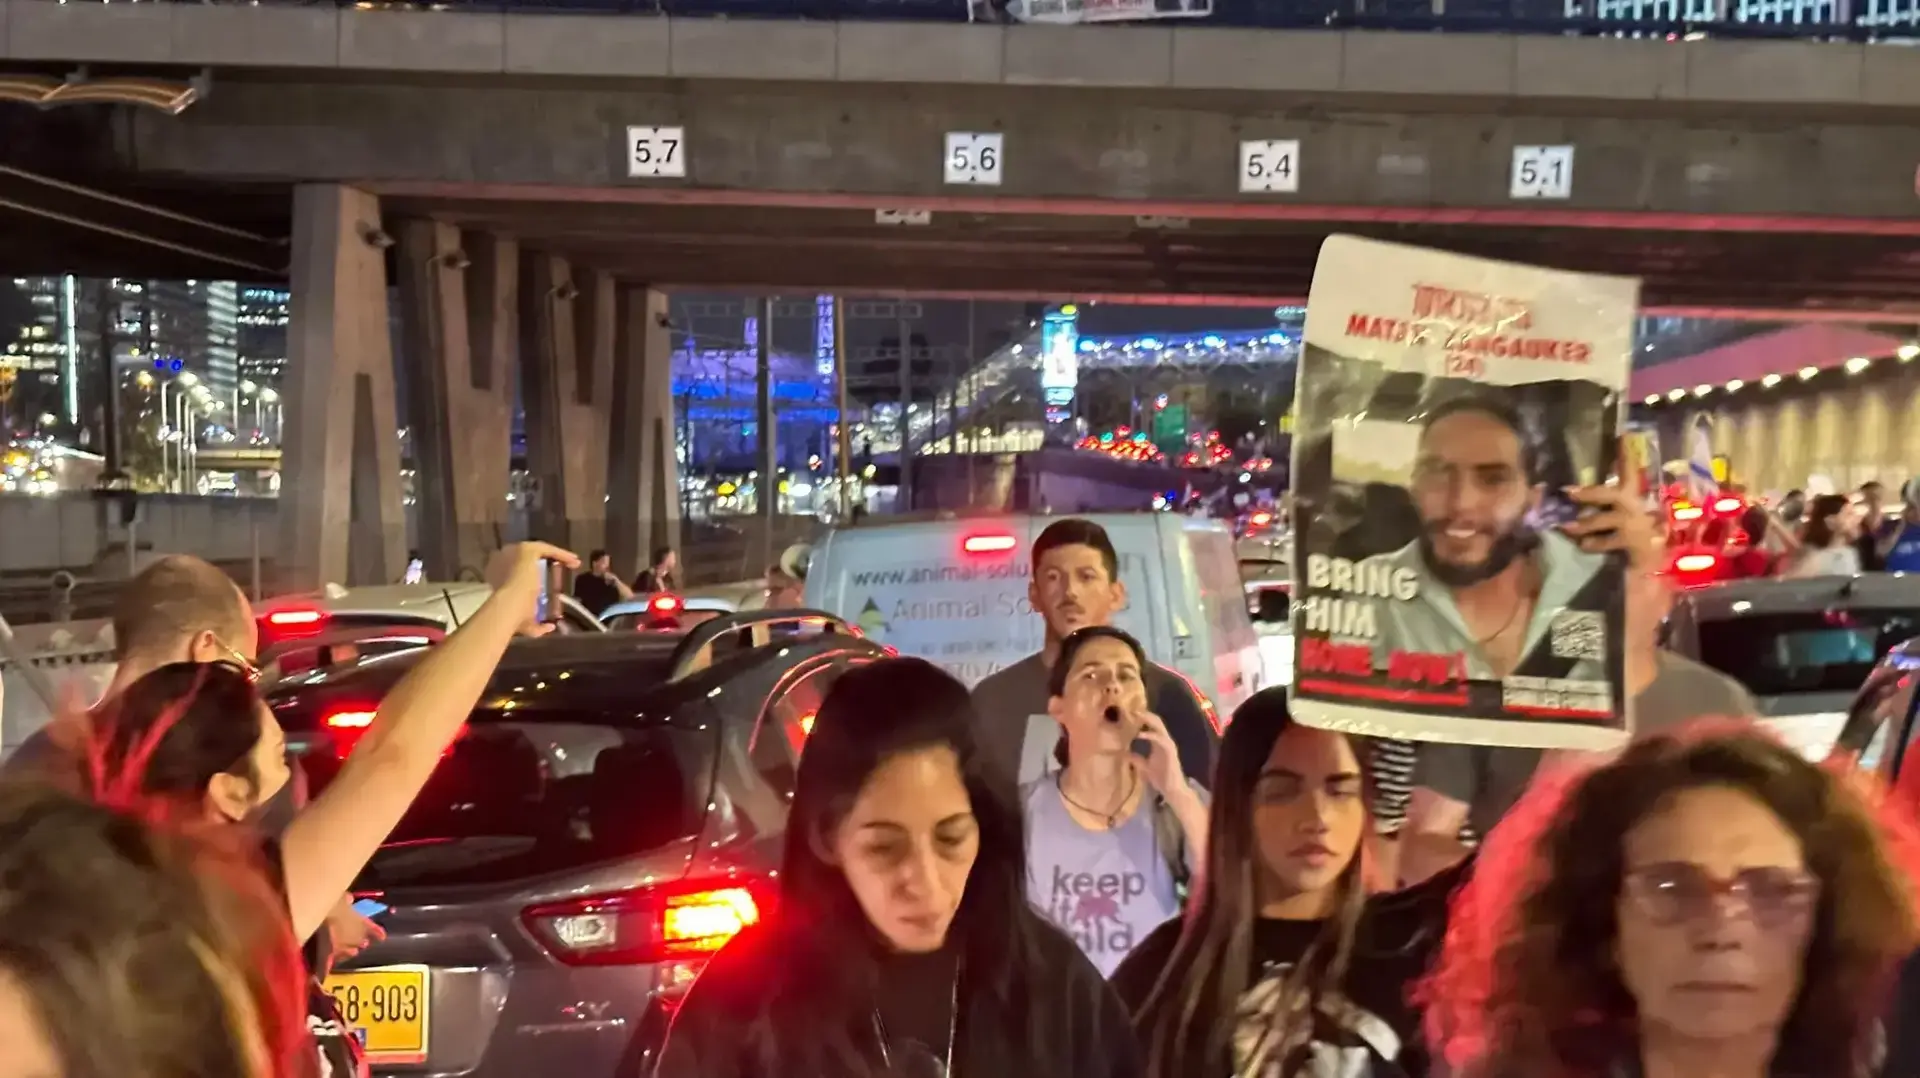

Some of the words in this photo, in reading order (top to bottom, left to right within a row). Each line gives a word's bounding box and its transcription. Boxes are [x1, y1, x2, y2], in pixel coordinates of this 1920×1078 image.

[634, 139, 679, 164] 5.7
[951, 145, 996, 172] 5.6
[1247, 153, 1292, 179] 5.4
[1519, 159, 1564, 186] 5.1
[1306, 553, 1420, 601] BRING
[892, 595, 988, 623] Animal
[1305, 595, 1378, 639] HIM
[1051, 864, 1146, 905] keep
[1076, 919, 1134, 953] ild
